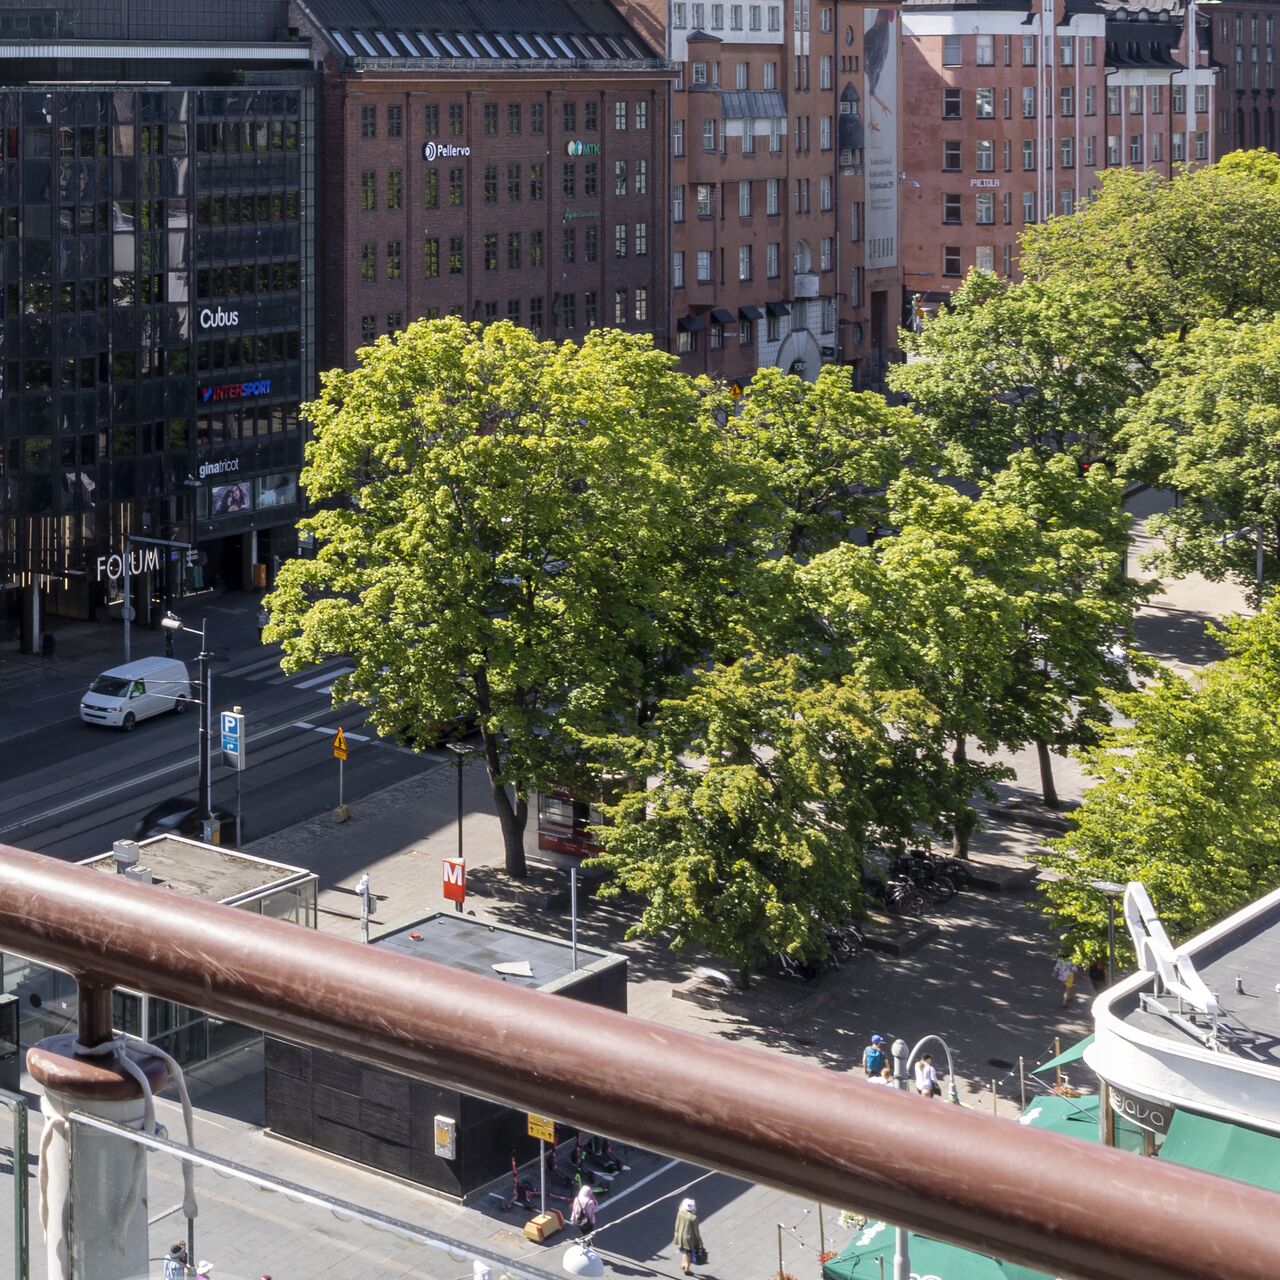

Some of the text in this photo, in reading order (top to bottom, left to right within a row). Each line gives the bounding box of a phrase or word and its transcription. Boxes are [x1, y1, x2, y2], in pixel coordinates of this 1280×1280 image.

[437, 144, 470, 157] Pellervo
[583, 143, 600, 156] MTK
[200, 306, 239, 329] Cubus
[213, 379, 272, 401] INTERSPORT
[225, 715, 236, 732] P
[443, 861, 463, 886] M
